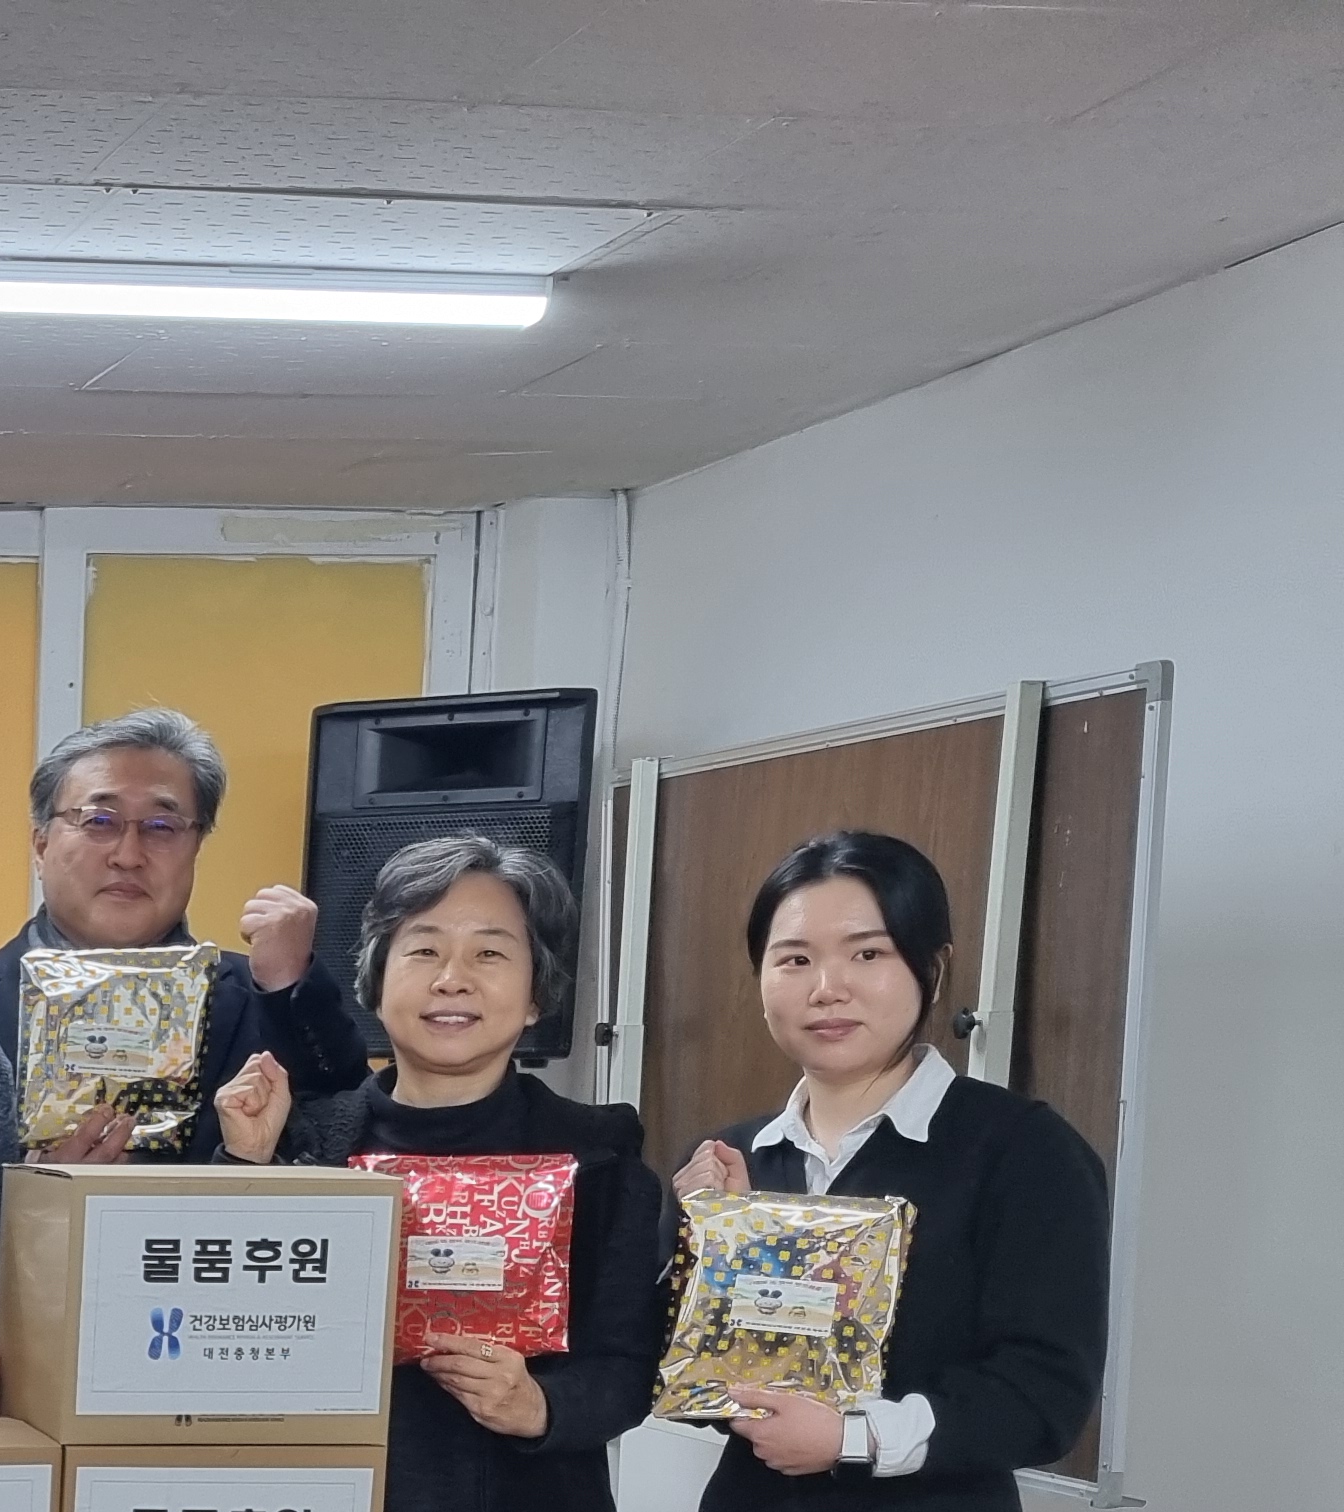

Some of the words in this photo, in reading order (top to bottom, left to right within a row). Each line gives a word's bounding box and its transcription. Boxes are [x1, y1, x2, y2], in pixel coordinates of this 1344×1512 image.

[141, 1238, 329, 1284] 물품후원
[189, 1314, 316, 1332] 건강보험심사평가원
[203, 1347, 291, 1361] 대전충청본부
